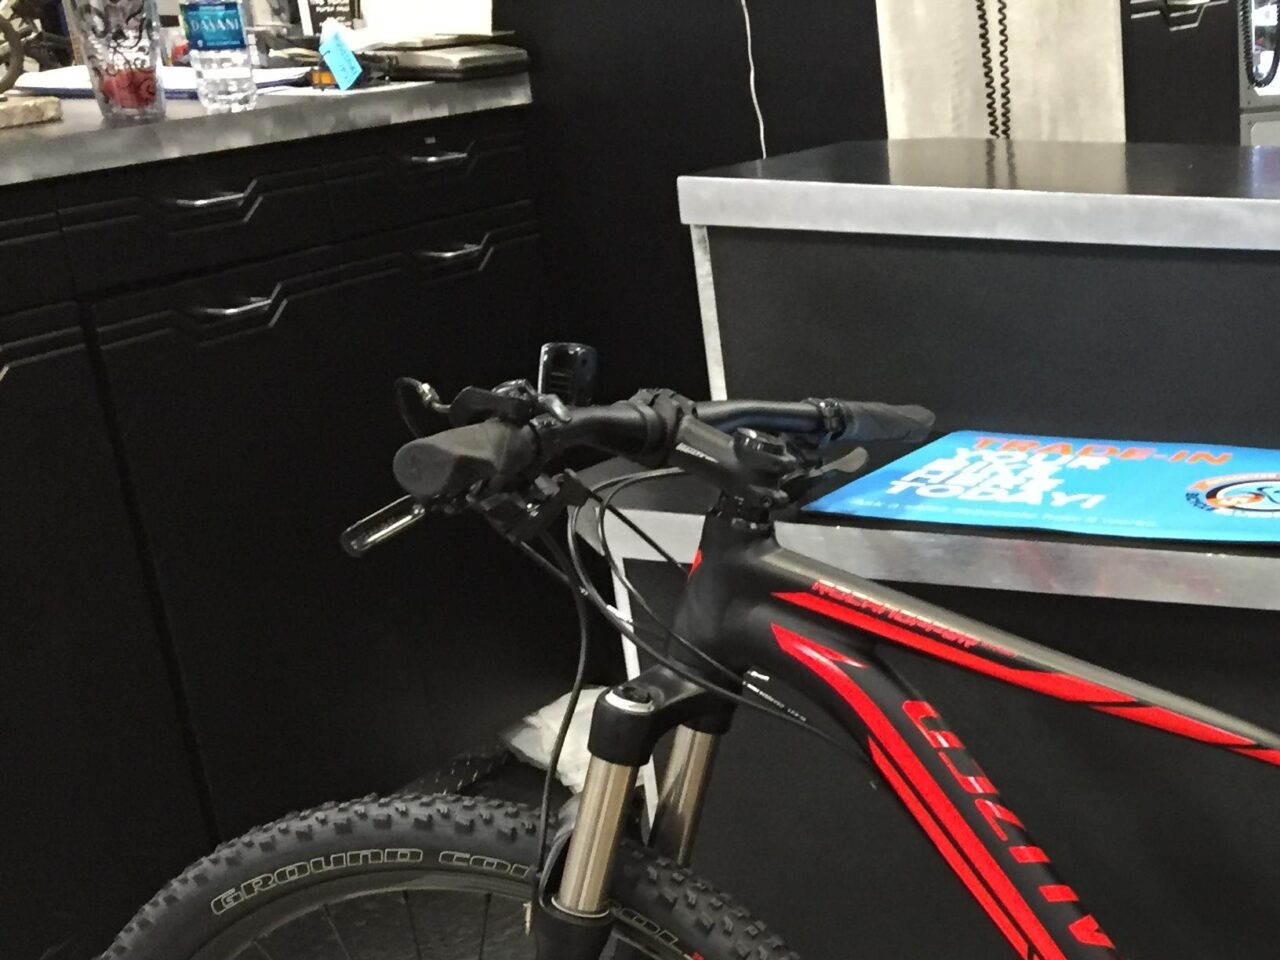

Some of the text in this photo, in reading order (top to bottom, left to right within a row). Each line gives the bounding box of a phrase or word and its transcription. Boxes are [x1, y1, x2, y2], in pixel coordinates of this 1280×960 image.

[190, 18, 240, 32] DASANI
[955, 447, 1111, 470] YOUR
[973, 436, 1233, 465] TRADE-IN
[885, 480, 1106, 508] TODAY!
[210, 848, 424, 915] GROUND
